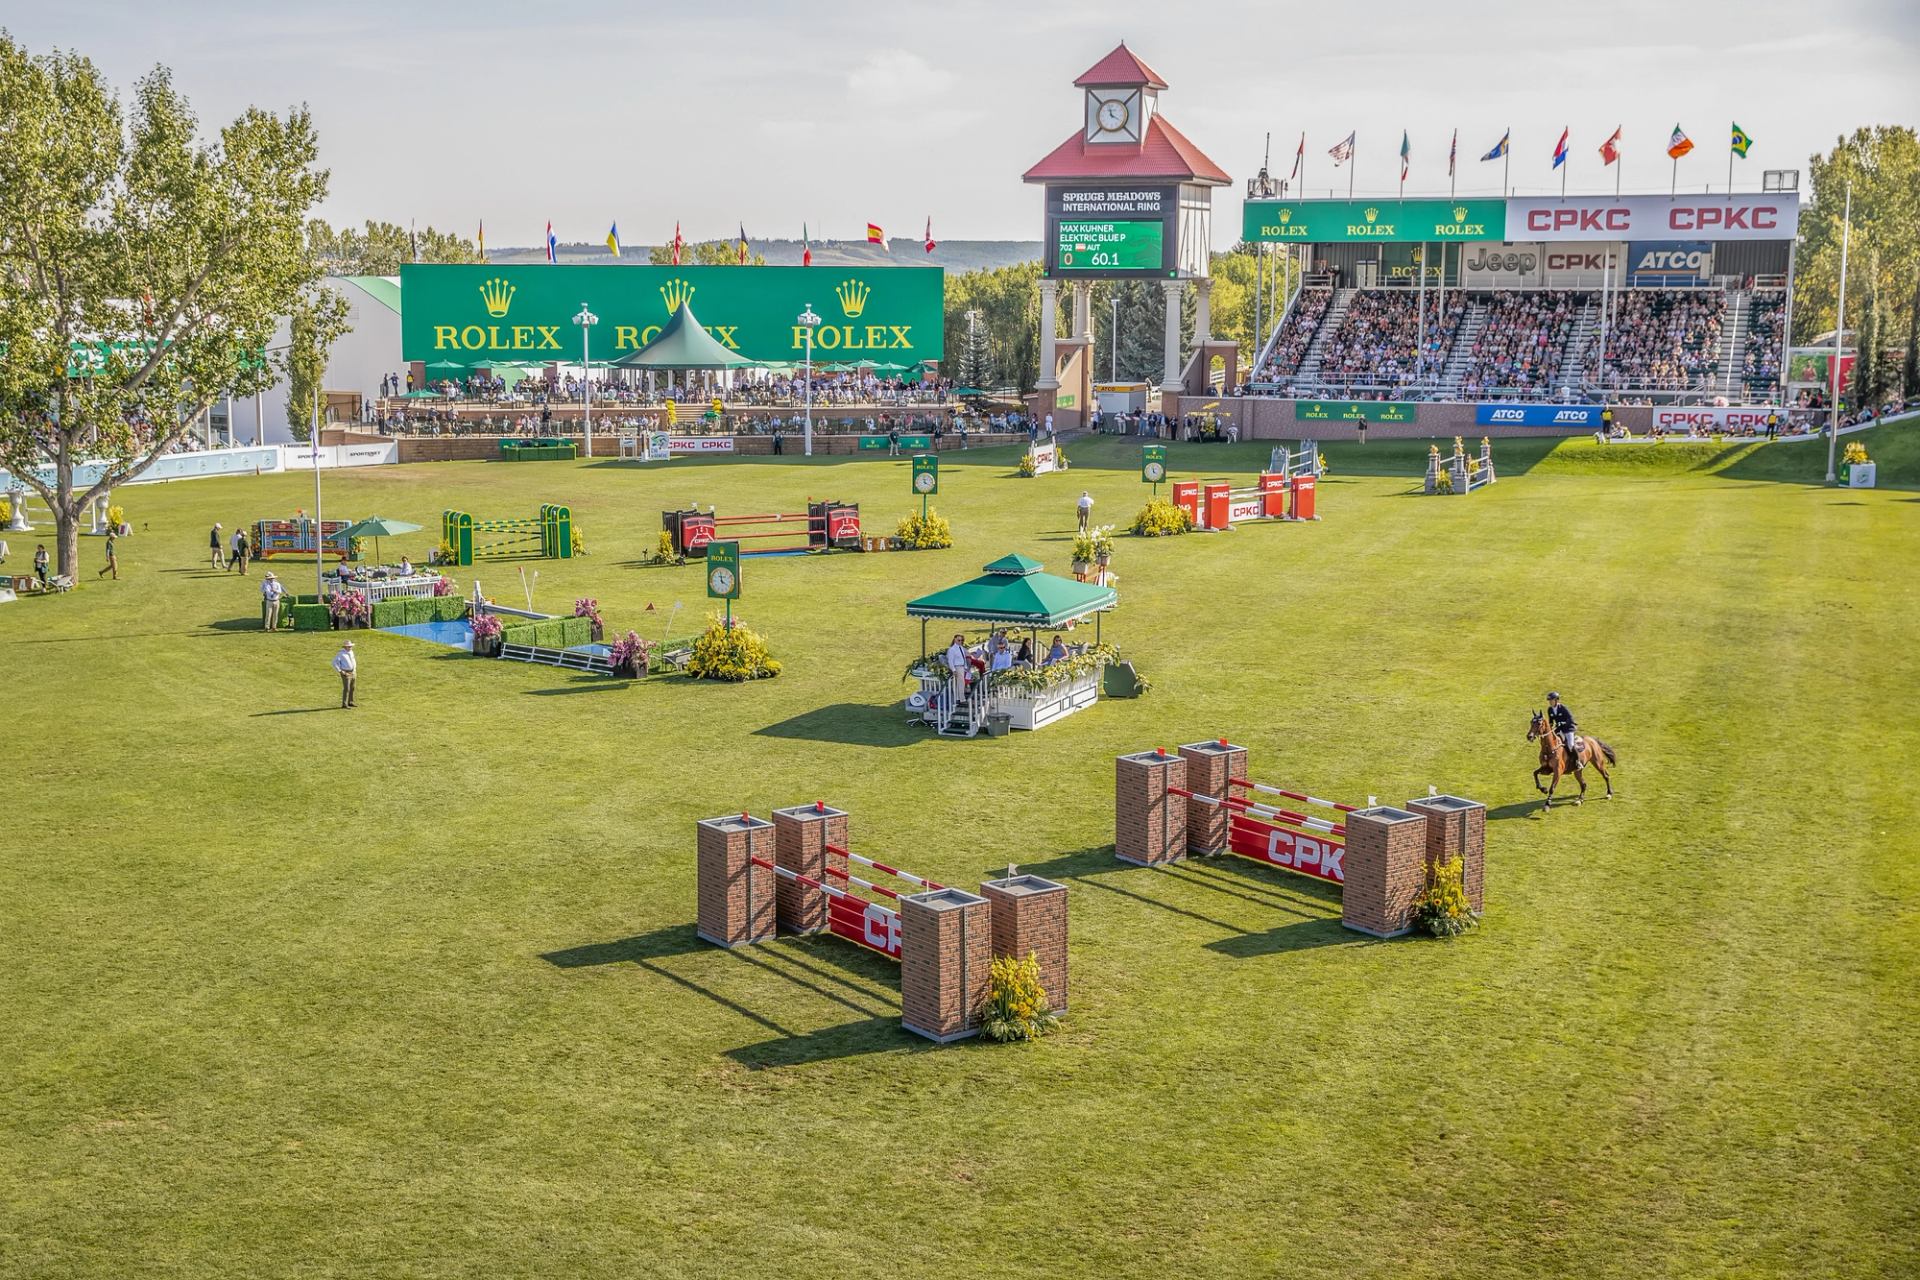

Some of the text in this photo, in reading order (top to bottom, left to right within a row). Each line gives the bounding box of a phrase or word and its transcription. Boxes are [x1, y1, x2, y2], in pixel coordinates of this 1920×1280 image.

[1107, 192, 1161, 201] MEADOWS
[1063, 202, 1160, 211] INTERNATIONAL RING
[1527, 209, 1631, 231] CPKC
[1669, 207, 1777, 230] CPKC
[1261, 225, 1308, 236] ROLEX
[1347, 225, 1395, 236] ROLEX
[1435, 224, 1485, 235] ROLEX
[1060, 234, 1126, 242] ELEKTRIC BLUE P
[1064, 253, 1119, 265] 0 60.1
[1467, 248, 1537, 275] Jeep
[1547, 254, 1617, 270] CPKC
[1638, 251, 1702, 269] ATCO
[434, 325, 563, 350] ROLEX
[614, 325, 741, 350] ROX
[791, 325, 914, 350] ROLEX
[1492, 409, 1524, 419] ATCO
[1555, 410, 1588, 420] ATCO
[1660, 413, 1714, 425] CPKC
[702, 441, 732, 449] CPKC
[1233, 505, 1260, 517] CPKC
[1267, 830, 1346, 880] CPK
[863, 907, 902, 953] CP
